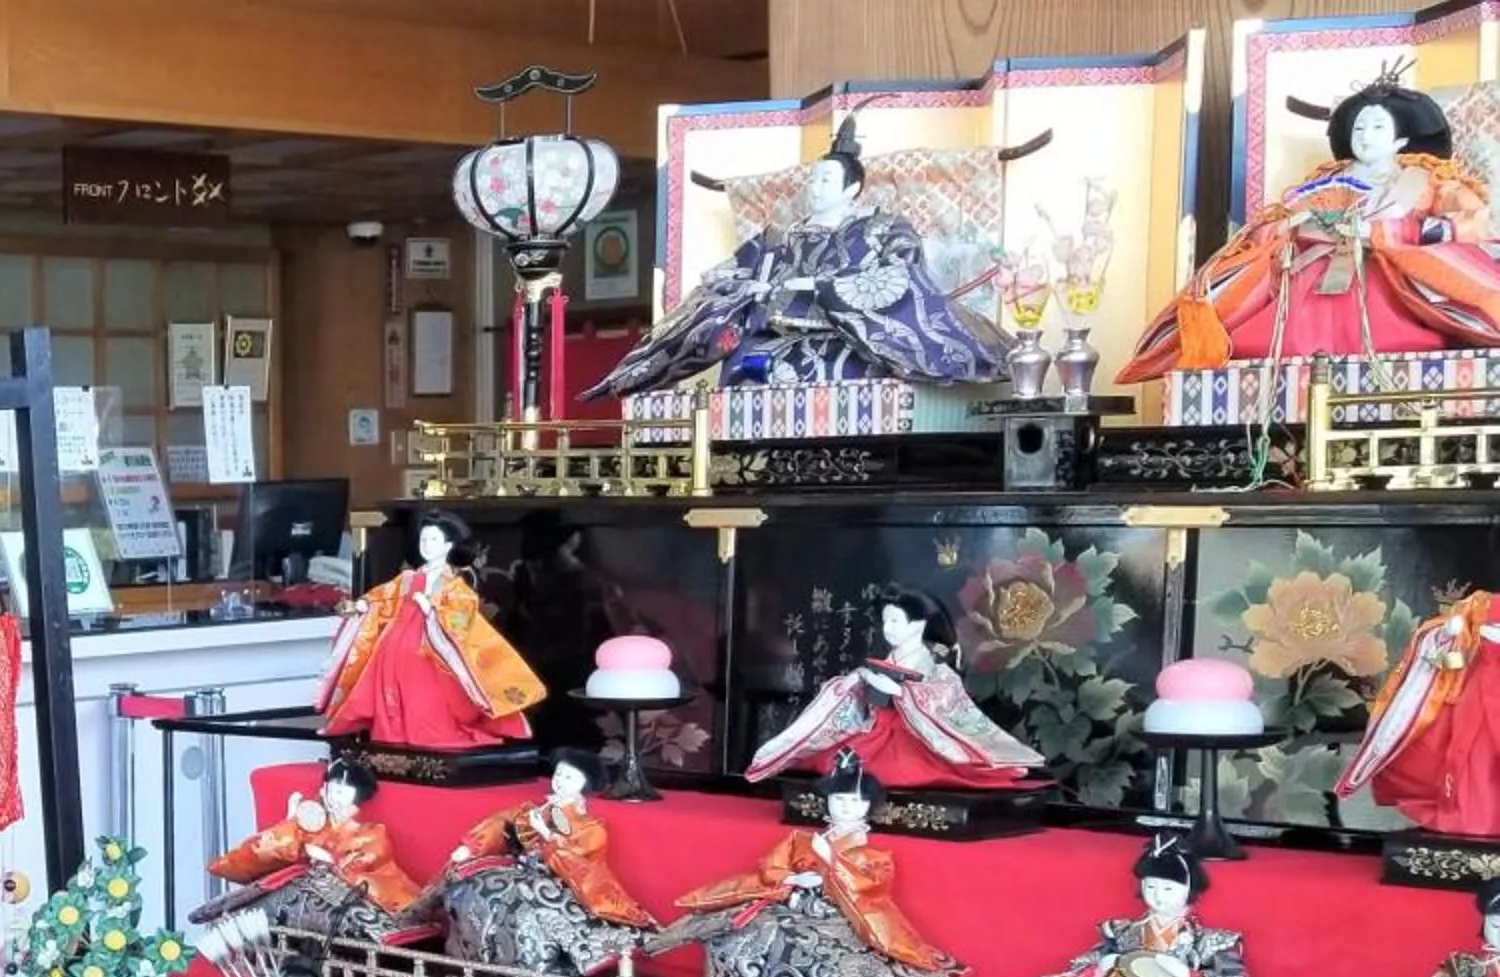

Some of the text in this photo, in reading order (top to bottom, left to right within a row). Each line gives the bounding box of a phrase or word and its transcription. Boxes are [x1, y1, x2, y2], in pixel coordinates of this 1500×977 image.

[73, 178, 188, 206] FRONT フロント
